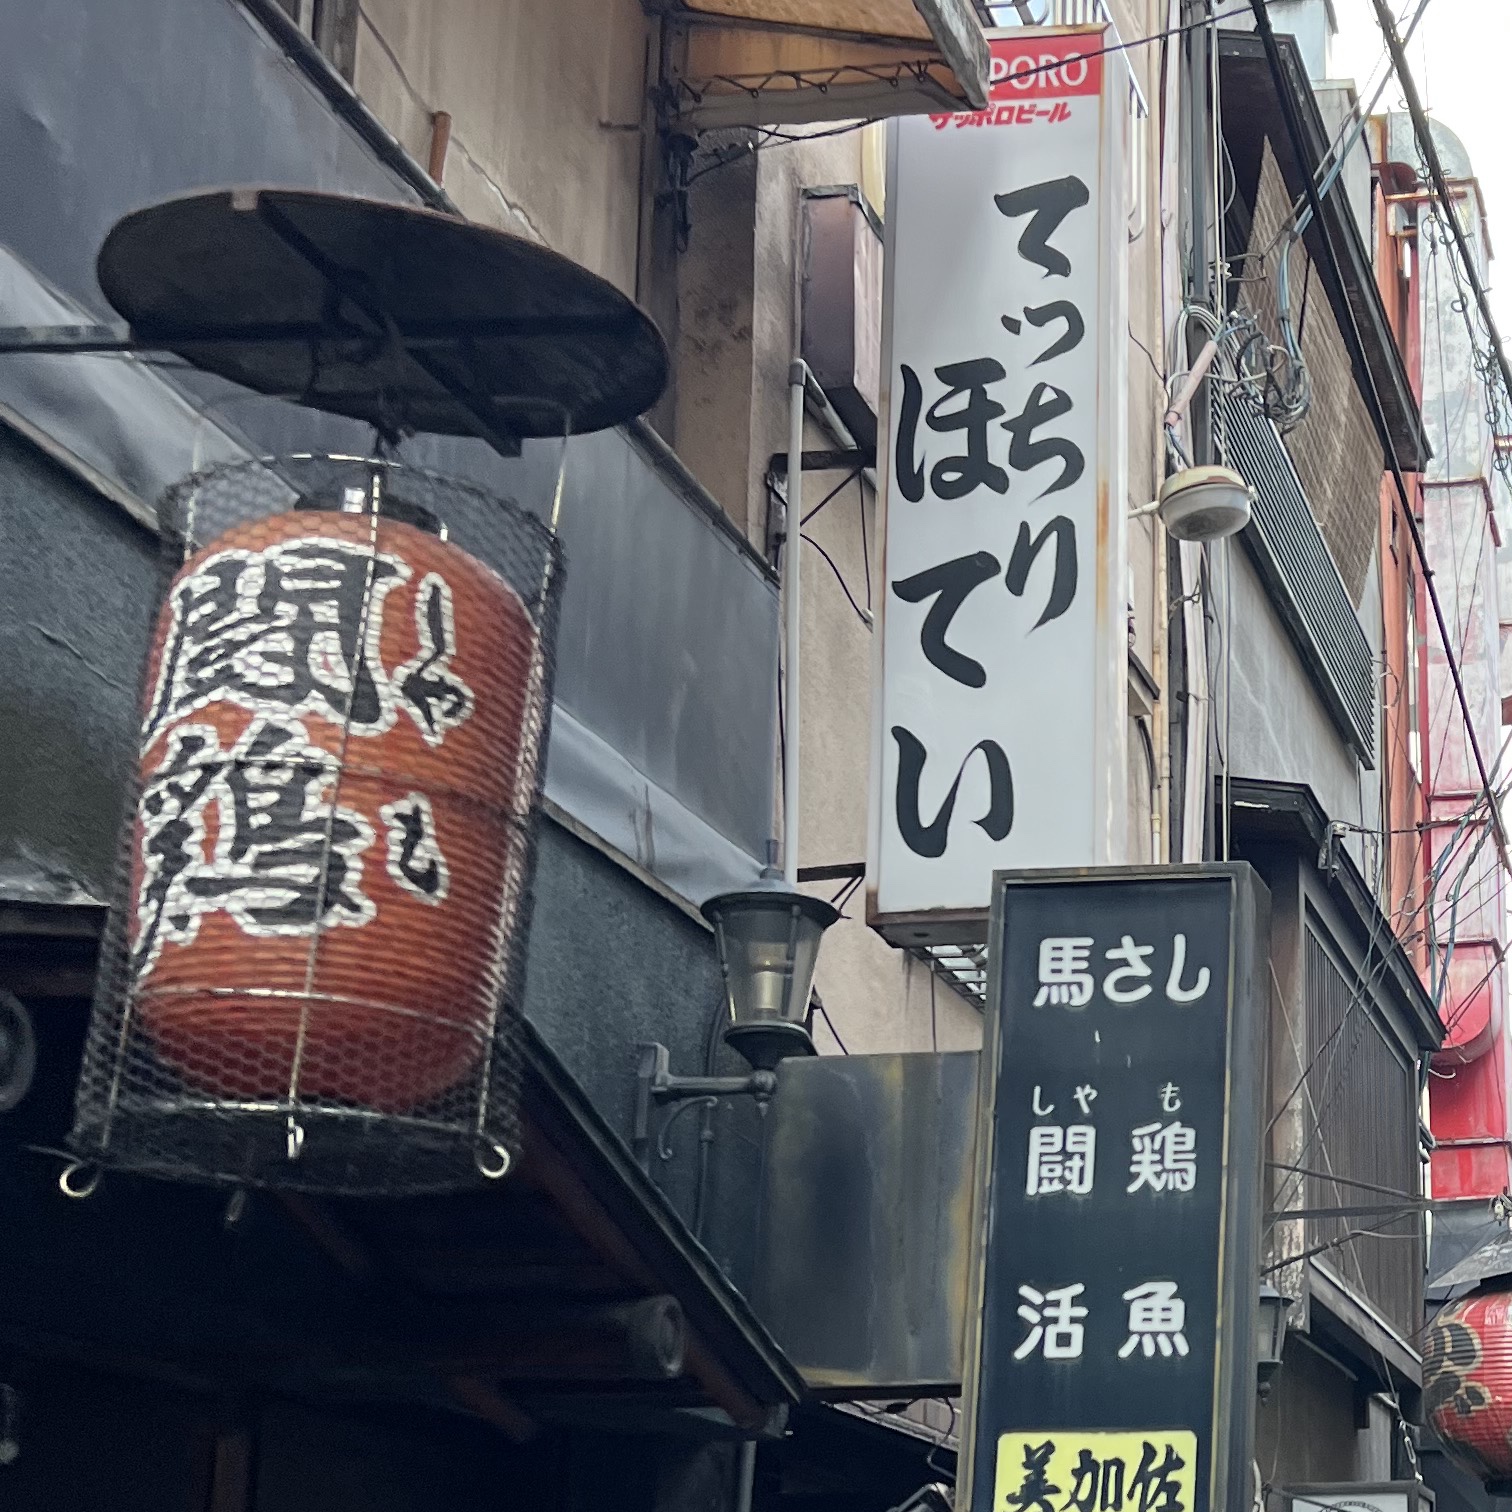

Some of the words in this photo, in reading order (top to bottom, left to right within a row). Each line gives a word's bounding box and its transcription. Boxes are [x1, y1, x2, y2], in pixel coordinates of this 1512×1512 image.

[890, 356, 1015, 859] ほてい
[1032, 933, 1211, 1007] 馬さし
[1025, 1121, 1198, 1196] 闘鶏
[1013, 1281, 1190, 1360] 活魚
